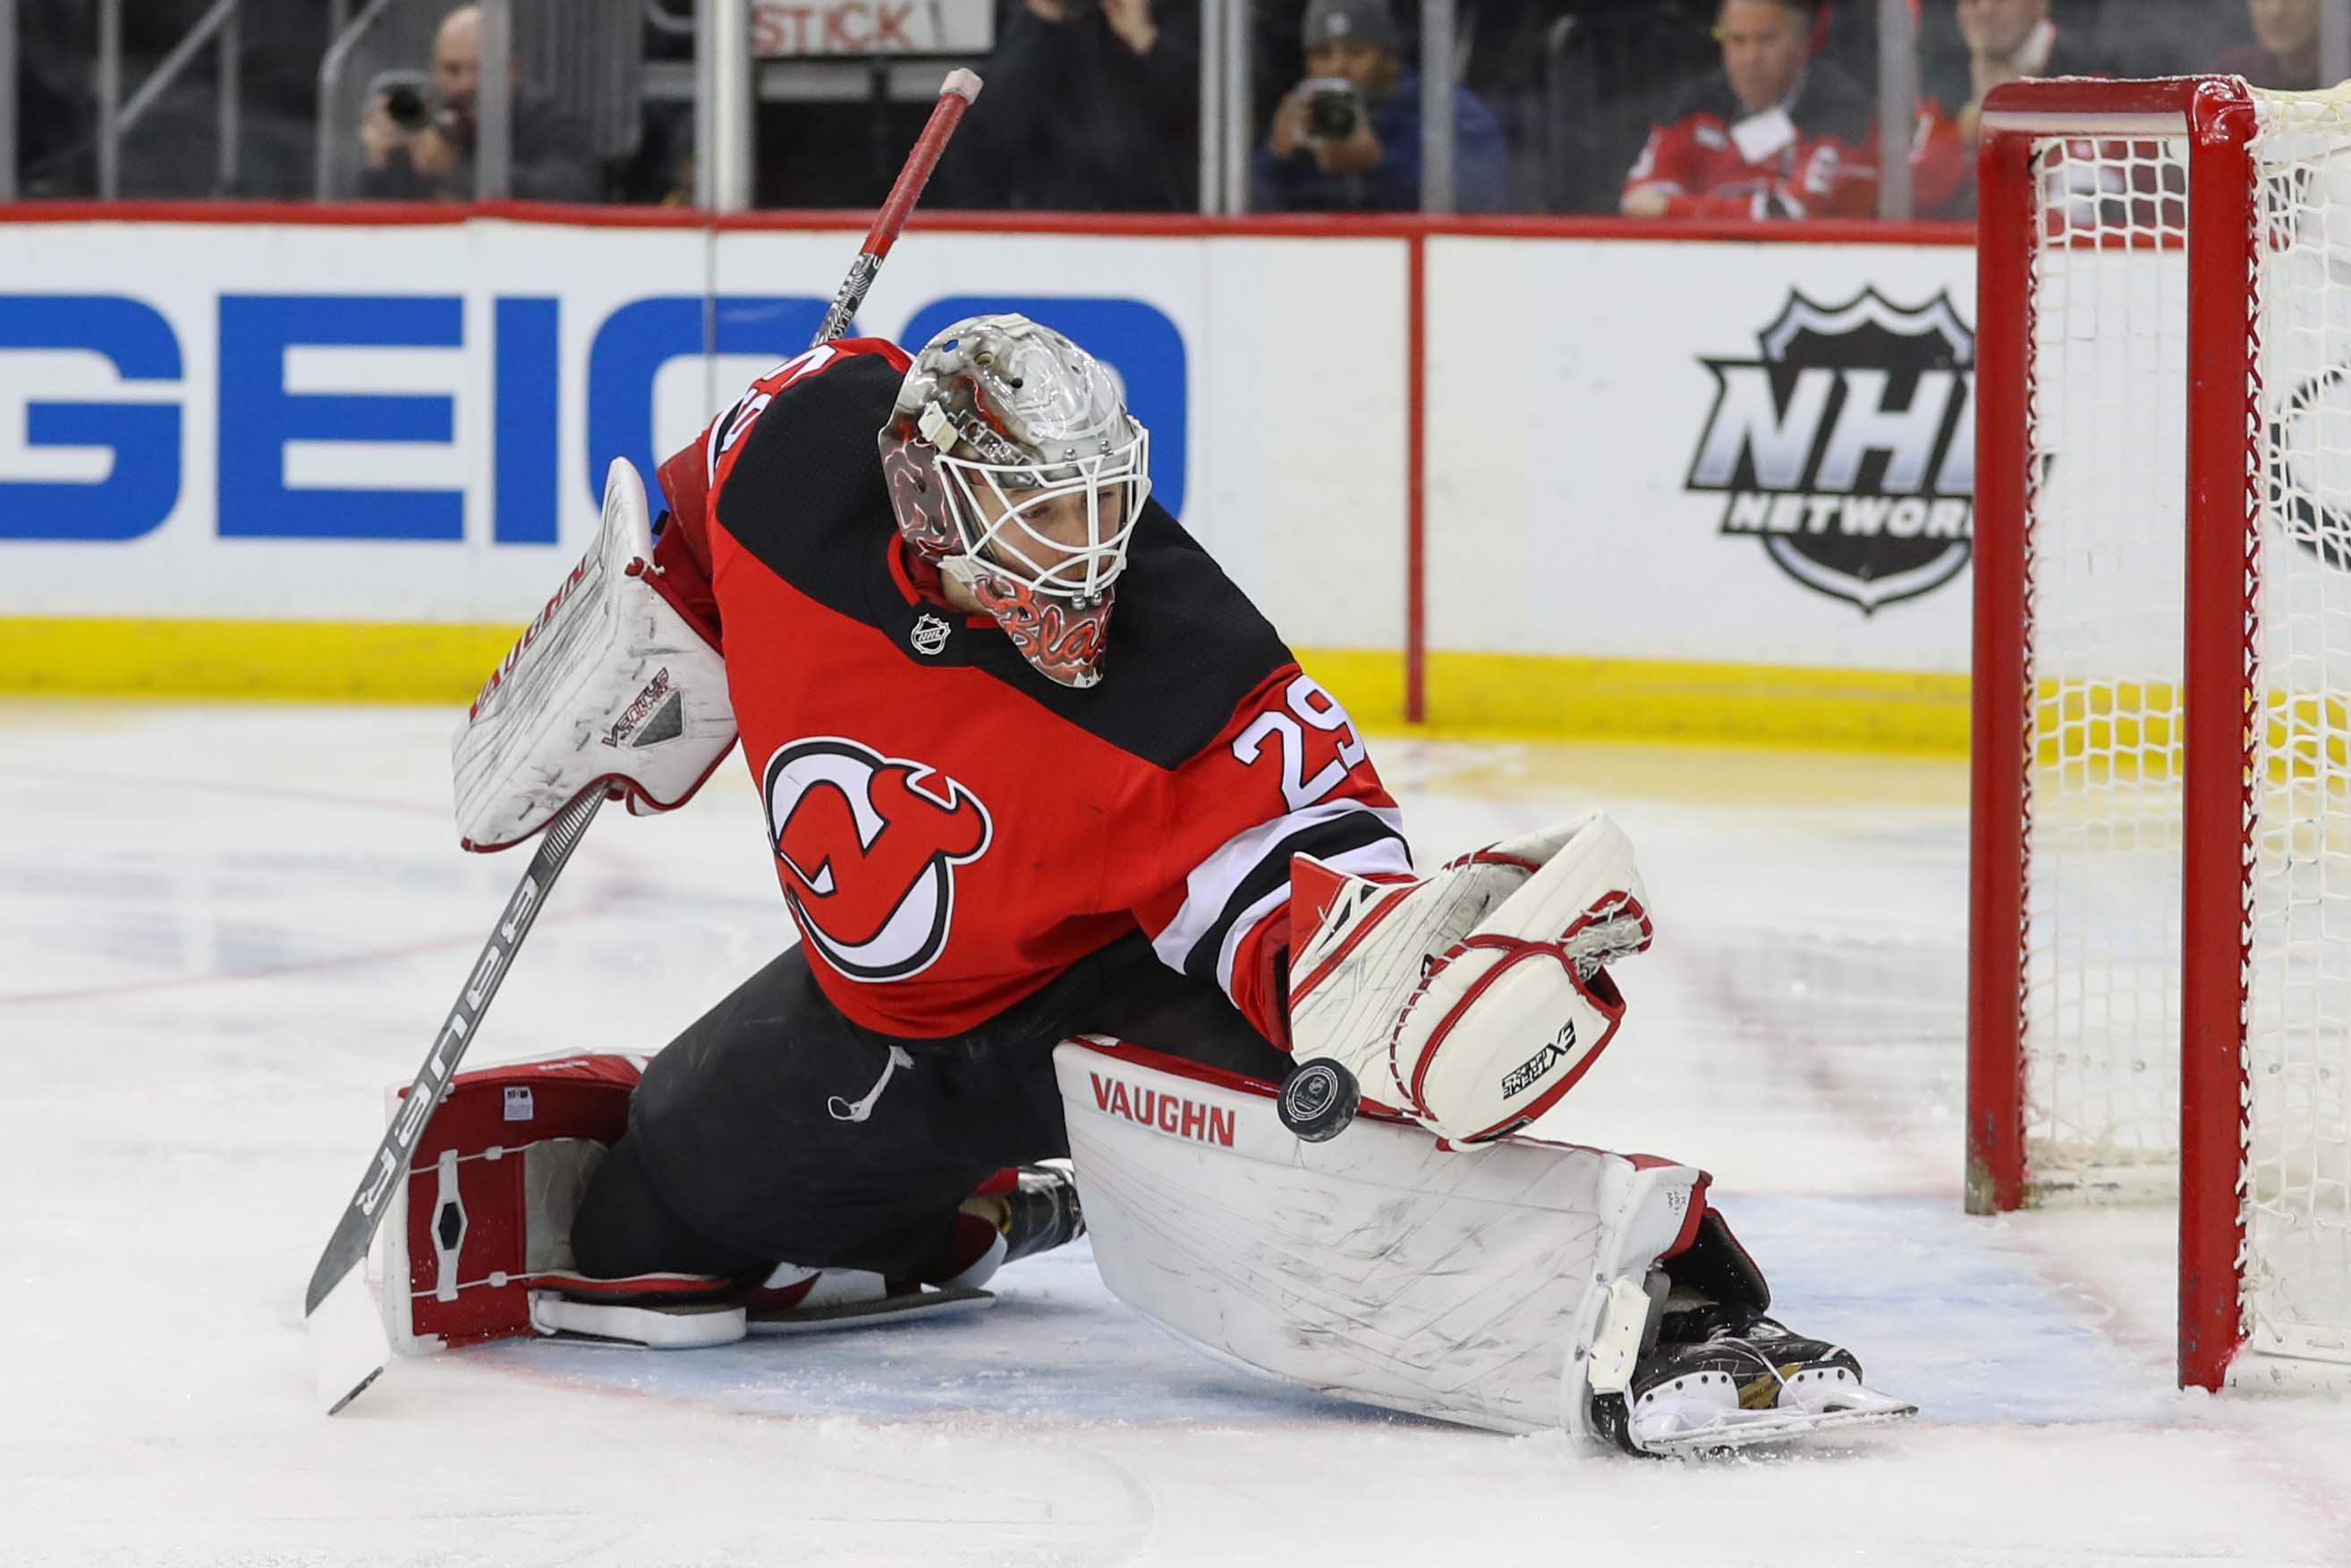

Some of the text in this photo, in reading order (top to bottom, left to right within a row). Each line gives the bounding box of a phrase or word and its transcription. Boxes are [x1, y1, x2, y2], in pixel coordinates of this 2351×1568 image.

[1727, 490, 1973, 539] NETWOR
[1232, 674, 1366, 812] 29
[355, 874, 540, 1217] BAUER
[1088, 1070, 1236, 1148] VAUGHN
